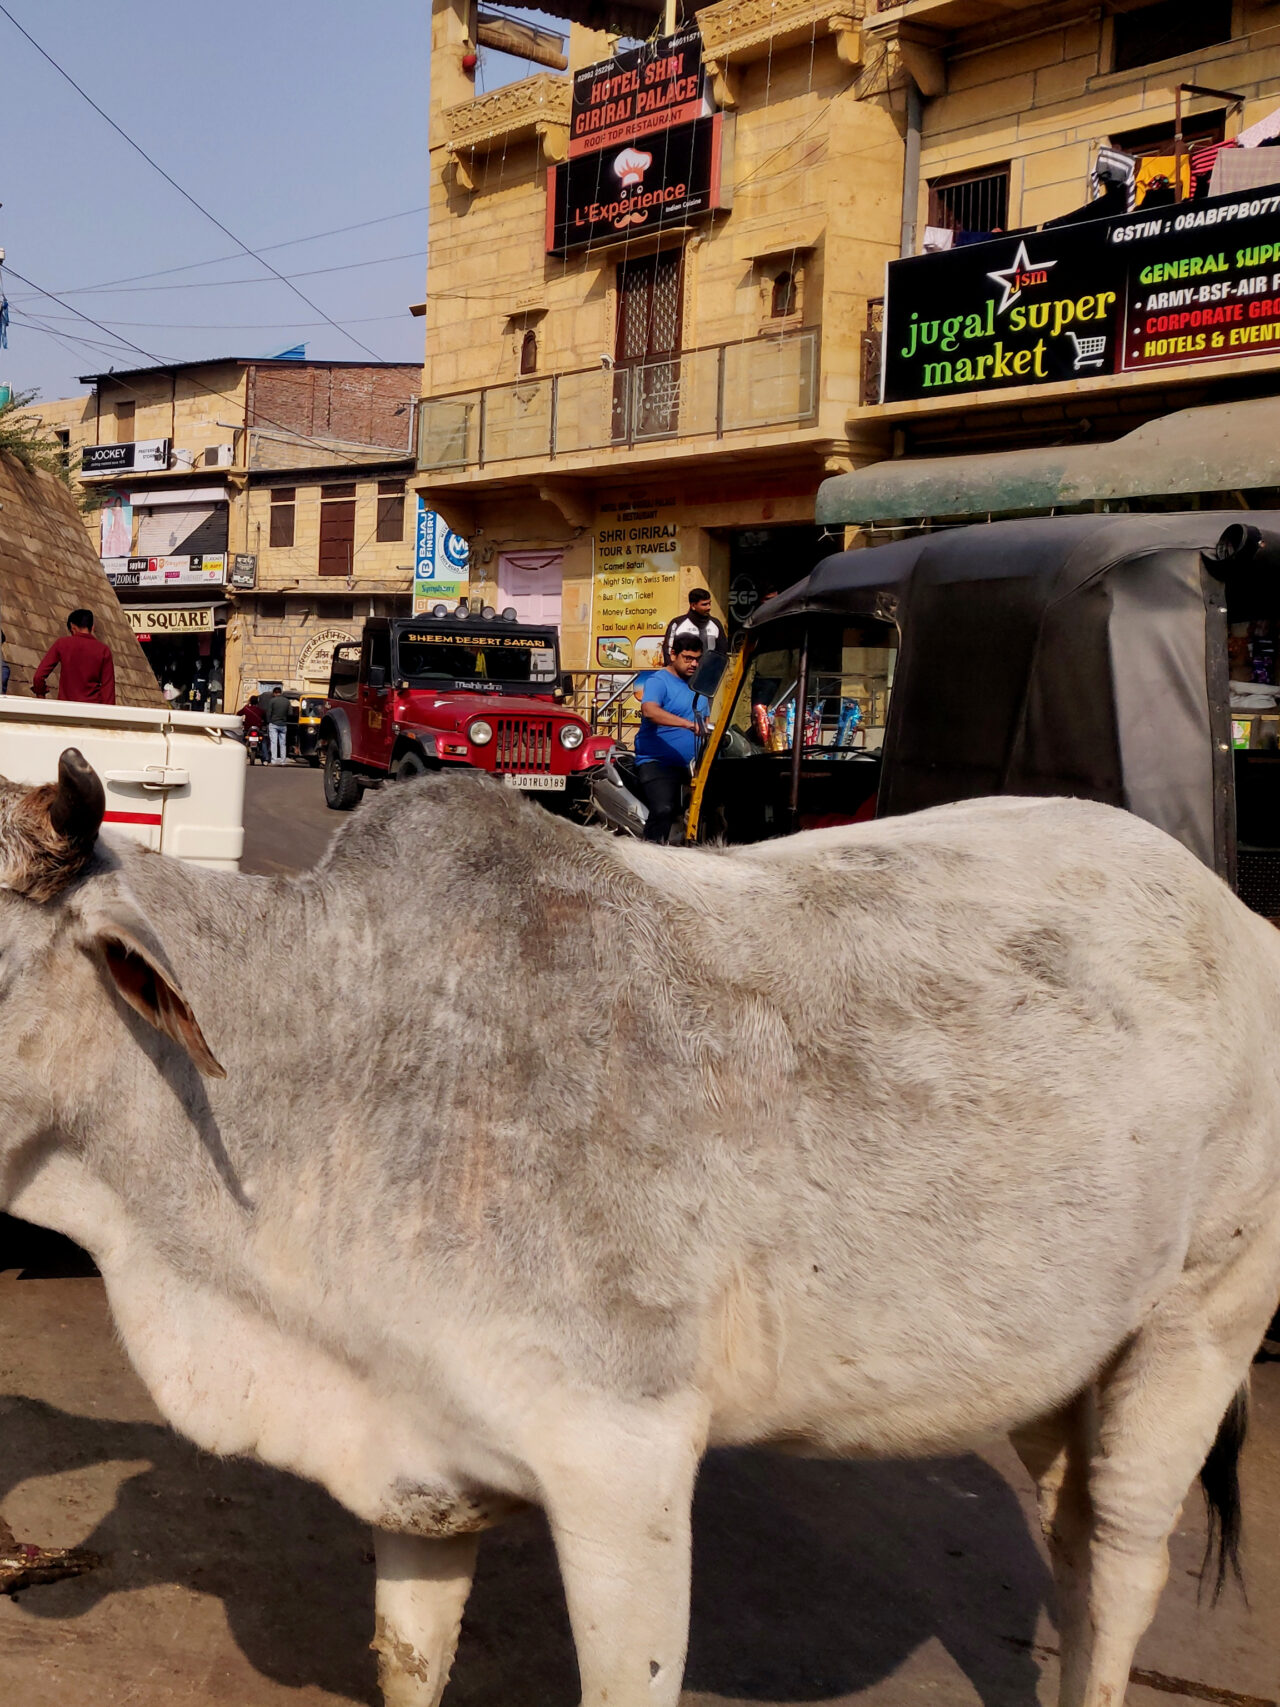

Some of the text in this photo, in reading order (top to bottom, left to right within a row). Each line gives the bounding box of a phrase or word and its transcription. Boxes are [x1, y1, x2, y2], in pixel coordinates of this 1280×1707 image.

[590, 53, 684, 105] HOTEL SHRI
[576, 74, 698, 135] GIRIRAJ PALACE
[584, 109, 683, 148] ROOF TOP RESTAURANT
[1112, 219, 1163, 243] GSTIN
[1175, 196, 1280, 231] 08ABFPB077
[1139, 252, 1230, 285] GENERAL
[1010, 267, 1048, 294] jsm
[1146, 275, 1268, 311] ARMY-BSF-AIR
[901, 291, 1117, 358] jugal super
[1146, 304, 1244, 334] CORPORATE
[1144, 333, 1207, 358] HOTELS
[1211, 331, 1226, 348] &
[922, 338, 1049, 387] market
[91, 448, 127, 461] JOCKEY
[419, 513, 427, 557] BAJAJ
[426, 513, 434, 557] FINSERV
[599, 524, 677, 543] SHRI GIRIRAJ
[599, 541, 677, 557] TOUR & TRAVELS
[129, 561, 147, 571] spykar
[603, 561, 645, 571] Camel Safari
[116, 573, 140, 585] ZODIAC
[603, 578, 620, 587] Night
[621, 577, 635, 585] Stay
[643, 575, 660, 584] Swiss
[618, 592, 633, 600] Train
[728, 591, 758, 605] SGP
[147, 612, 209, 629] SQUARE
[603, 607, 657, 616] Money Exchange
[408, 634, 545, 647] BHEEM DESERT SAFARI
[455, 681, 502, 690] Mahindra
[512, 776, 564, 787] GJ01RL0189
